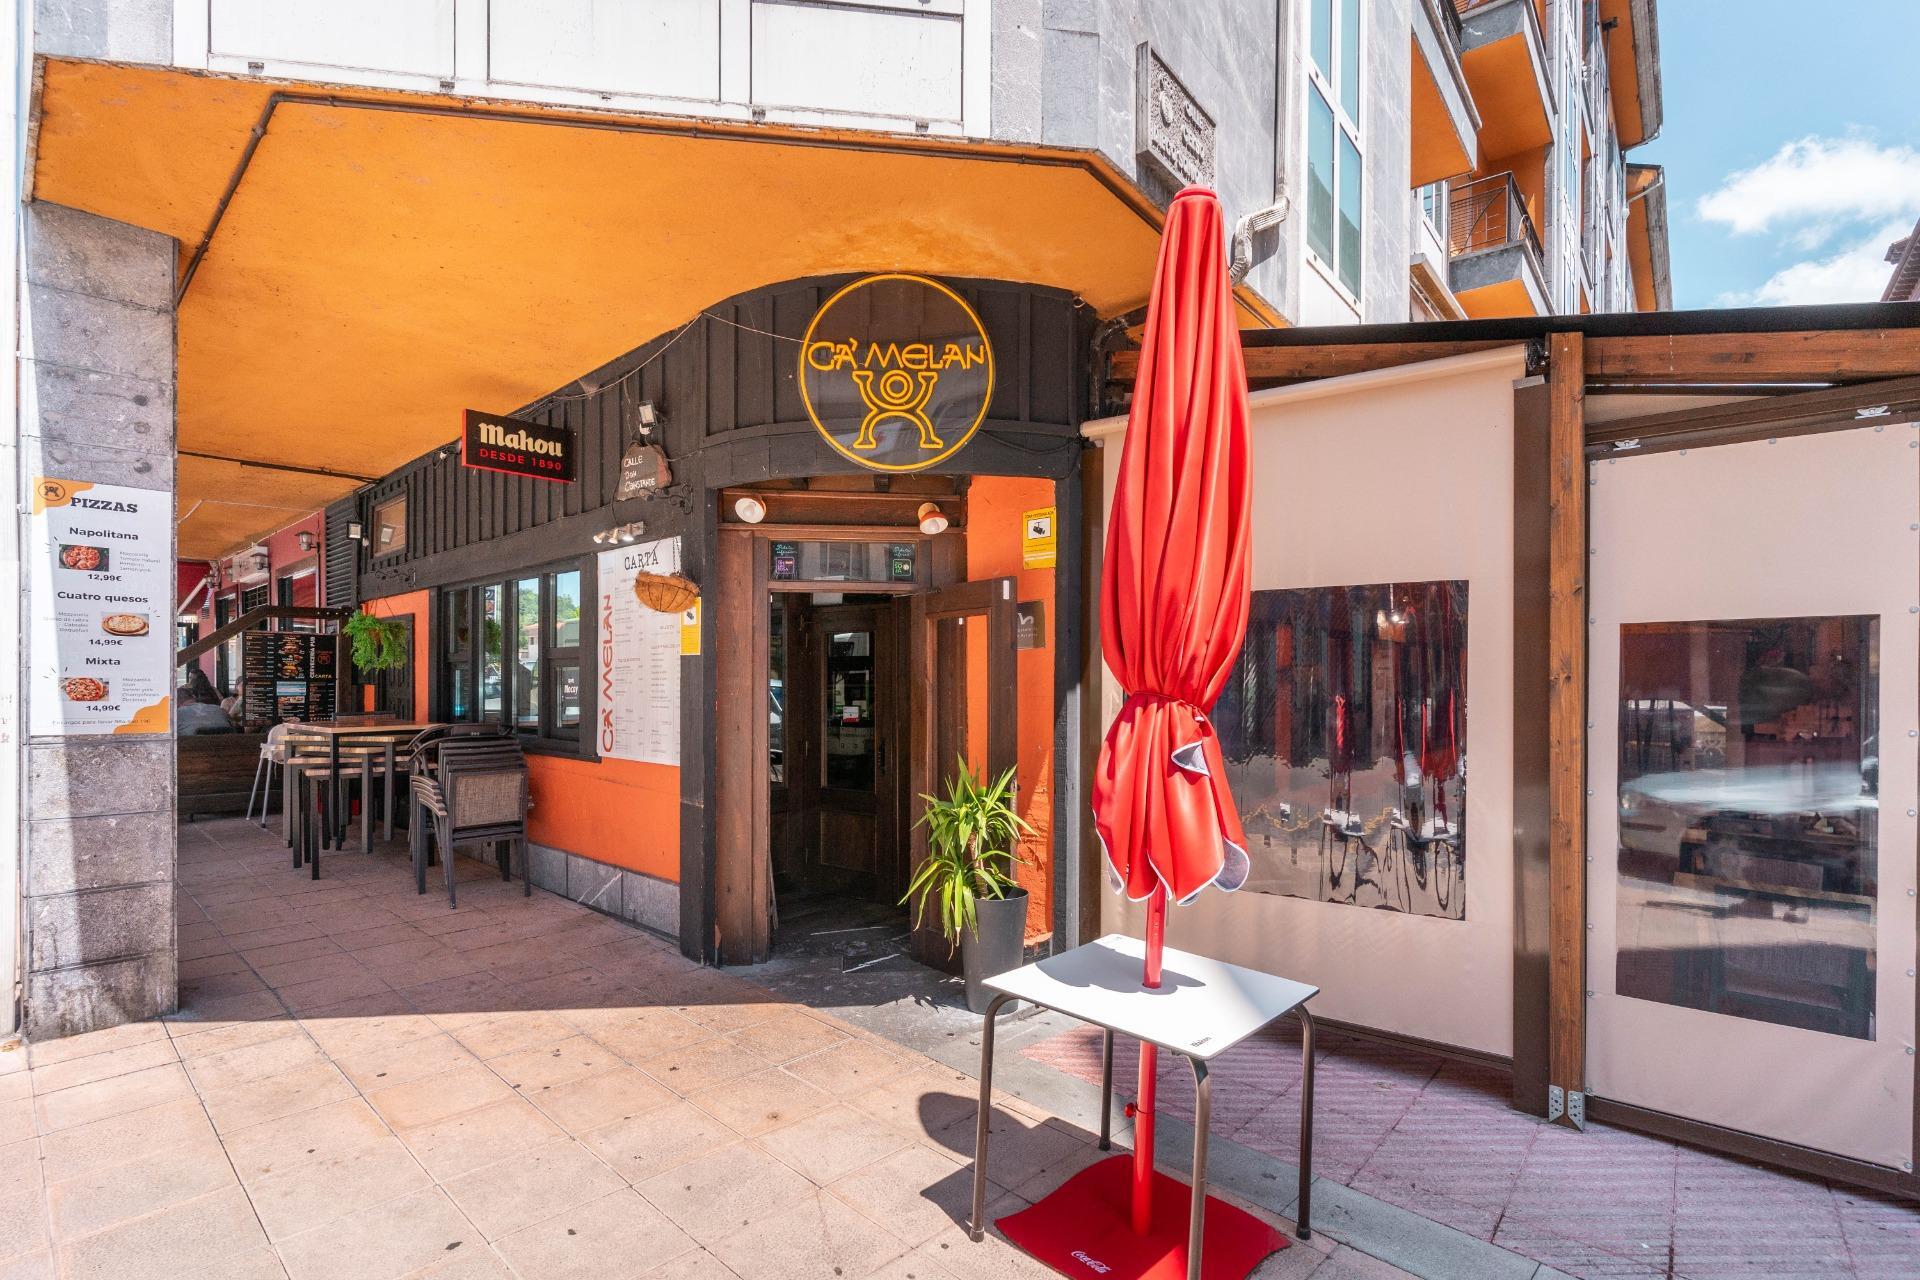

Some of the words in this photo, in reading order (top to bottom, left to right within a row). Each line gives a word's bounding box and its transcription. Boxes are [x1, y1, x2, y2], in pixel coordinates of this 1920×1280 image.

[478, 422, 563, 457] Mahou
[479, 448, 525, 464] DESDE
[532, 457, 562, 471] 1890
[623, 455, 643, 467] CALLE
[70, 496, 138, 513] PIZZAS
[69, 526, 139, 540] Napolitana
[624, 550, 659, 571] CARTA
[57, 591, 101, 601] Cuatro
[104, 595, 149, 603] quesos
[85, 657, 121, 665] Mixta
[86, 704, 121, 712] 14,99€
